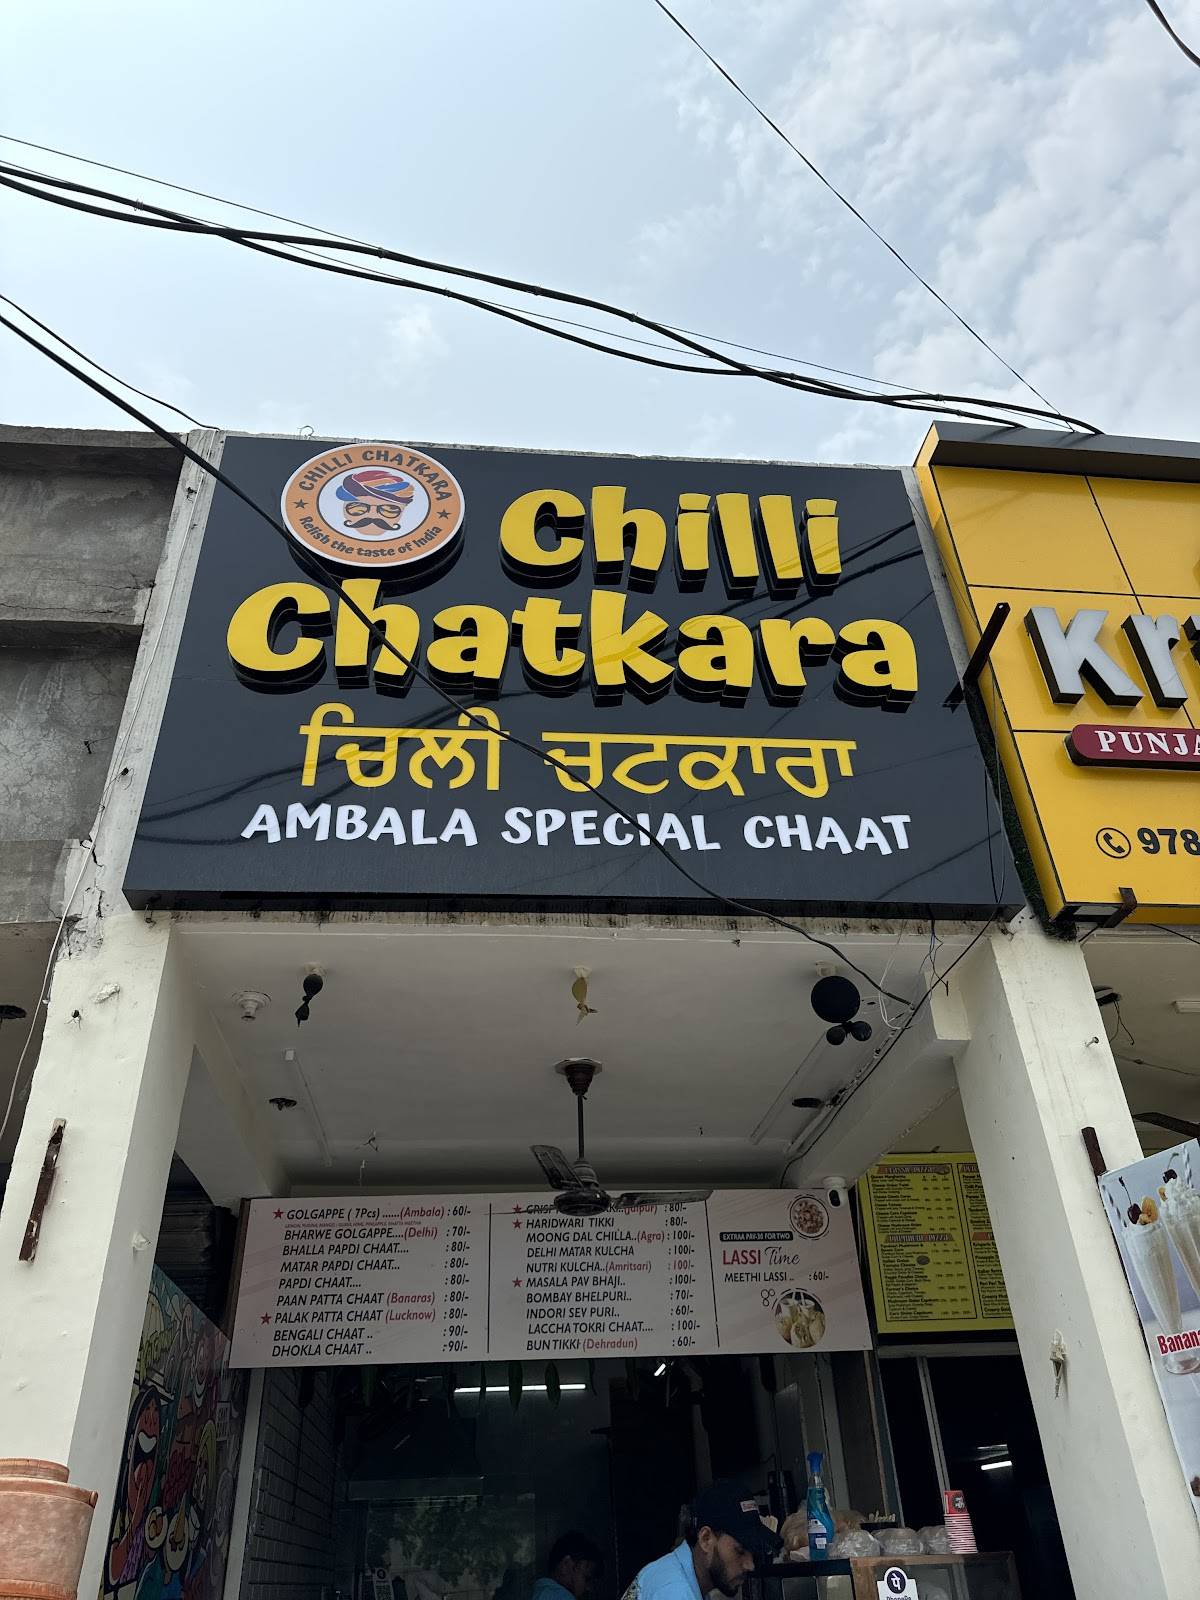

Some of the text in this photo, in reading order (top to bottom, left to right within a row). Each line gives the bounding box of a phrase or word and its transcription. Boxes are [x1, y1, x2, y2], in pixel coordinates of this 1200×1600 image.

[299, 450, 453, 501] CHILLI CHATKARA
[299, 516, 442, 557] Relish the taste of India
[500, 486, 842, 580] Chilli
[226, 579, 918, 692] Chatkara
[1024, 605, 1200, 710] Kr
[299, 703, 857, 798] ਚਿਲੀ ਚਟਕਾਰਾ
[241, 802, 911, 854] AMBALA SPECIAL CHAAT
[286, 1209, 344, 1220] GOLGAPPE
[401, 1207, 444, 1219] (Ambala)
[526, 1218, 584, 1228] HARIDWARI
[589, 1217, 614, 1228] TIKKI
[284, 1228, 331, 1240] BHARWE
[404, 1226, 438, 1240] (Delhi)
[526, 1232, 569, 1242] MOONG
[572, 1232, 593, 1242] DAL
[282, 1244, 325, 1256] BHALLA
[328, 1244, 360, 1255] PAPDI
[527, 1246, 556, 1257] DELHI
[559, 1246, 592, 1257] MATAR
[594, 1245, 634, 1256] KULCHA
[722, 1247, 800, 1265] LASSI Time
[281, 1261, 319, 1272] MATAR
[322, 1260, 354, 1271] PAPDI
[526, 1261, 558, 1272] NUTRI
[526, 1276, 568, 1287] MASALA
[571, 1276, 589, 1286] PAV
[724, 1272, 761, 1282] MEETHI
[764, 1271, 788, 1282] LASSI
[279, 1278, 312, 1289] PAPDI
[277, 1295, 307, 1306] PAAN
[310, 1294, 344, 1305] PATTA
[346, 1293, 384, 1304] CHAAT
[526, 1292, 572, 1303] BOMBAY
[275, 1312, 308, 1324] PALAK
[311, 1312, 343, 1323] PATTA
[346, 1310, 383, 1321] CHAAT
[526, 1307, 566, 1319] INDORI
[569, 1307, 587, 1318] SEV
[274, 1330, 323, 1341] BENGALI
[327, 1328, 364, 1340] CHAAT
[1157, 1330, 1200, 1354] Banan
[272, 1346, 322, 1357] DHOKLA
[325, 1344, 364, 1355] CHAAT
